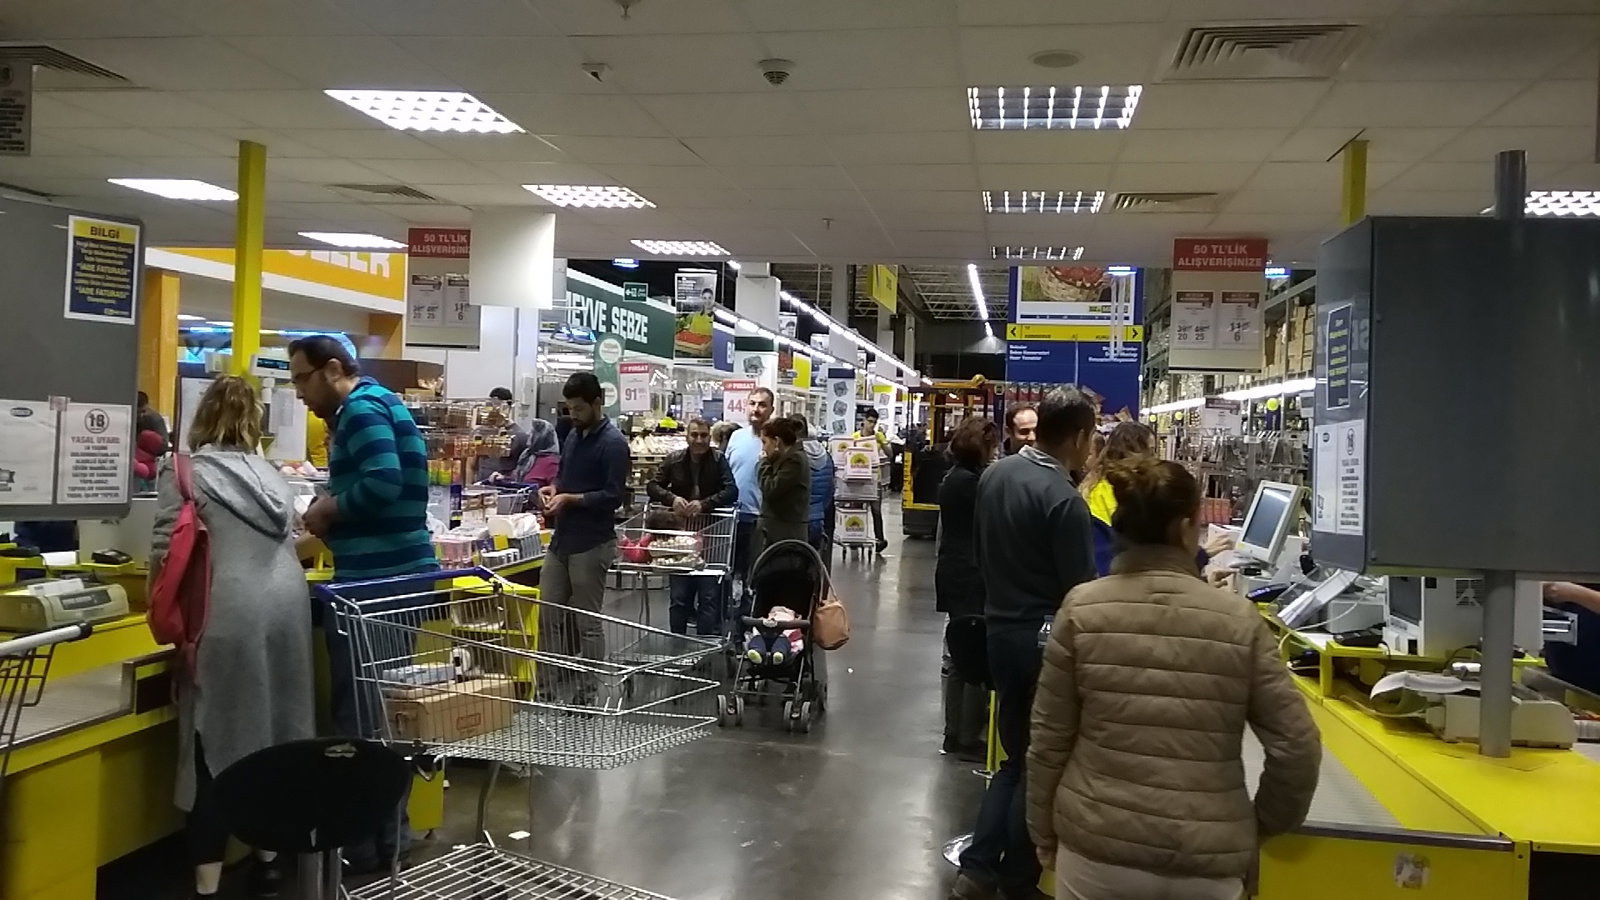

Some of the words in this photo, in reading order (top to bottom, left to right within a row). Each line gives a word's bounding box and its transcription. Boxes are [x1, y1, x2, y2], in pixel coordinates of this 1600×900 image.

[424, 234, 435, 242] 50
[1193, 245, 1207, 254] 50
[611, 306, 649, 344] SEBZE
[1234, 331, 1241, 341] 6
[89, 414, 105, 428] 18
